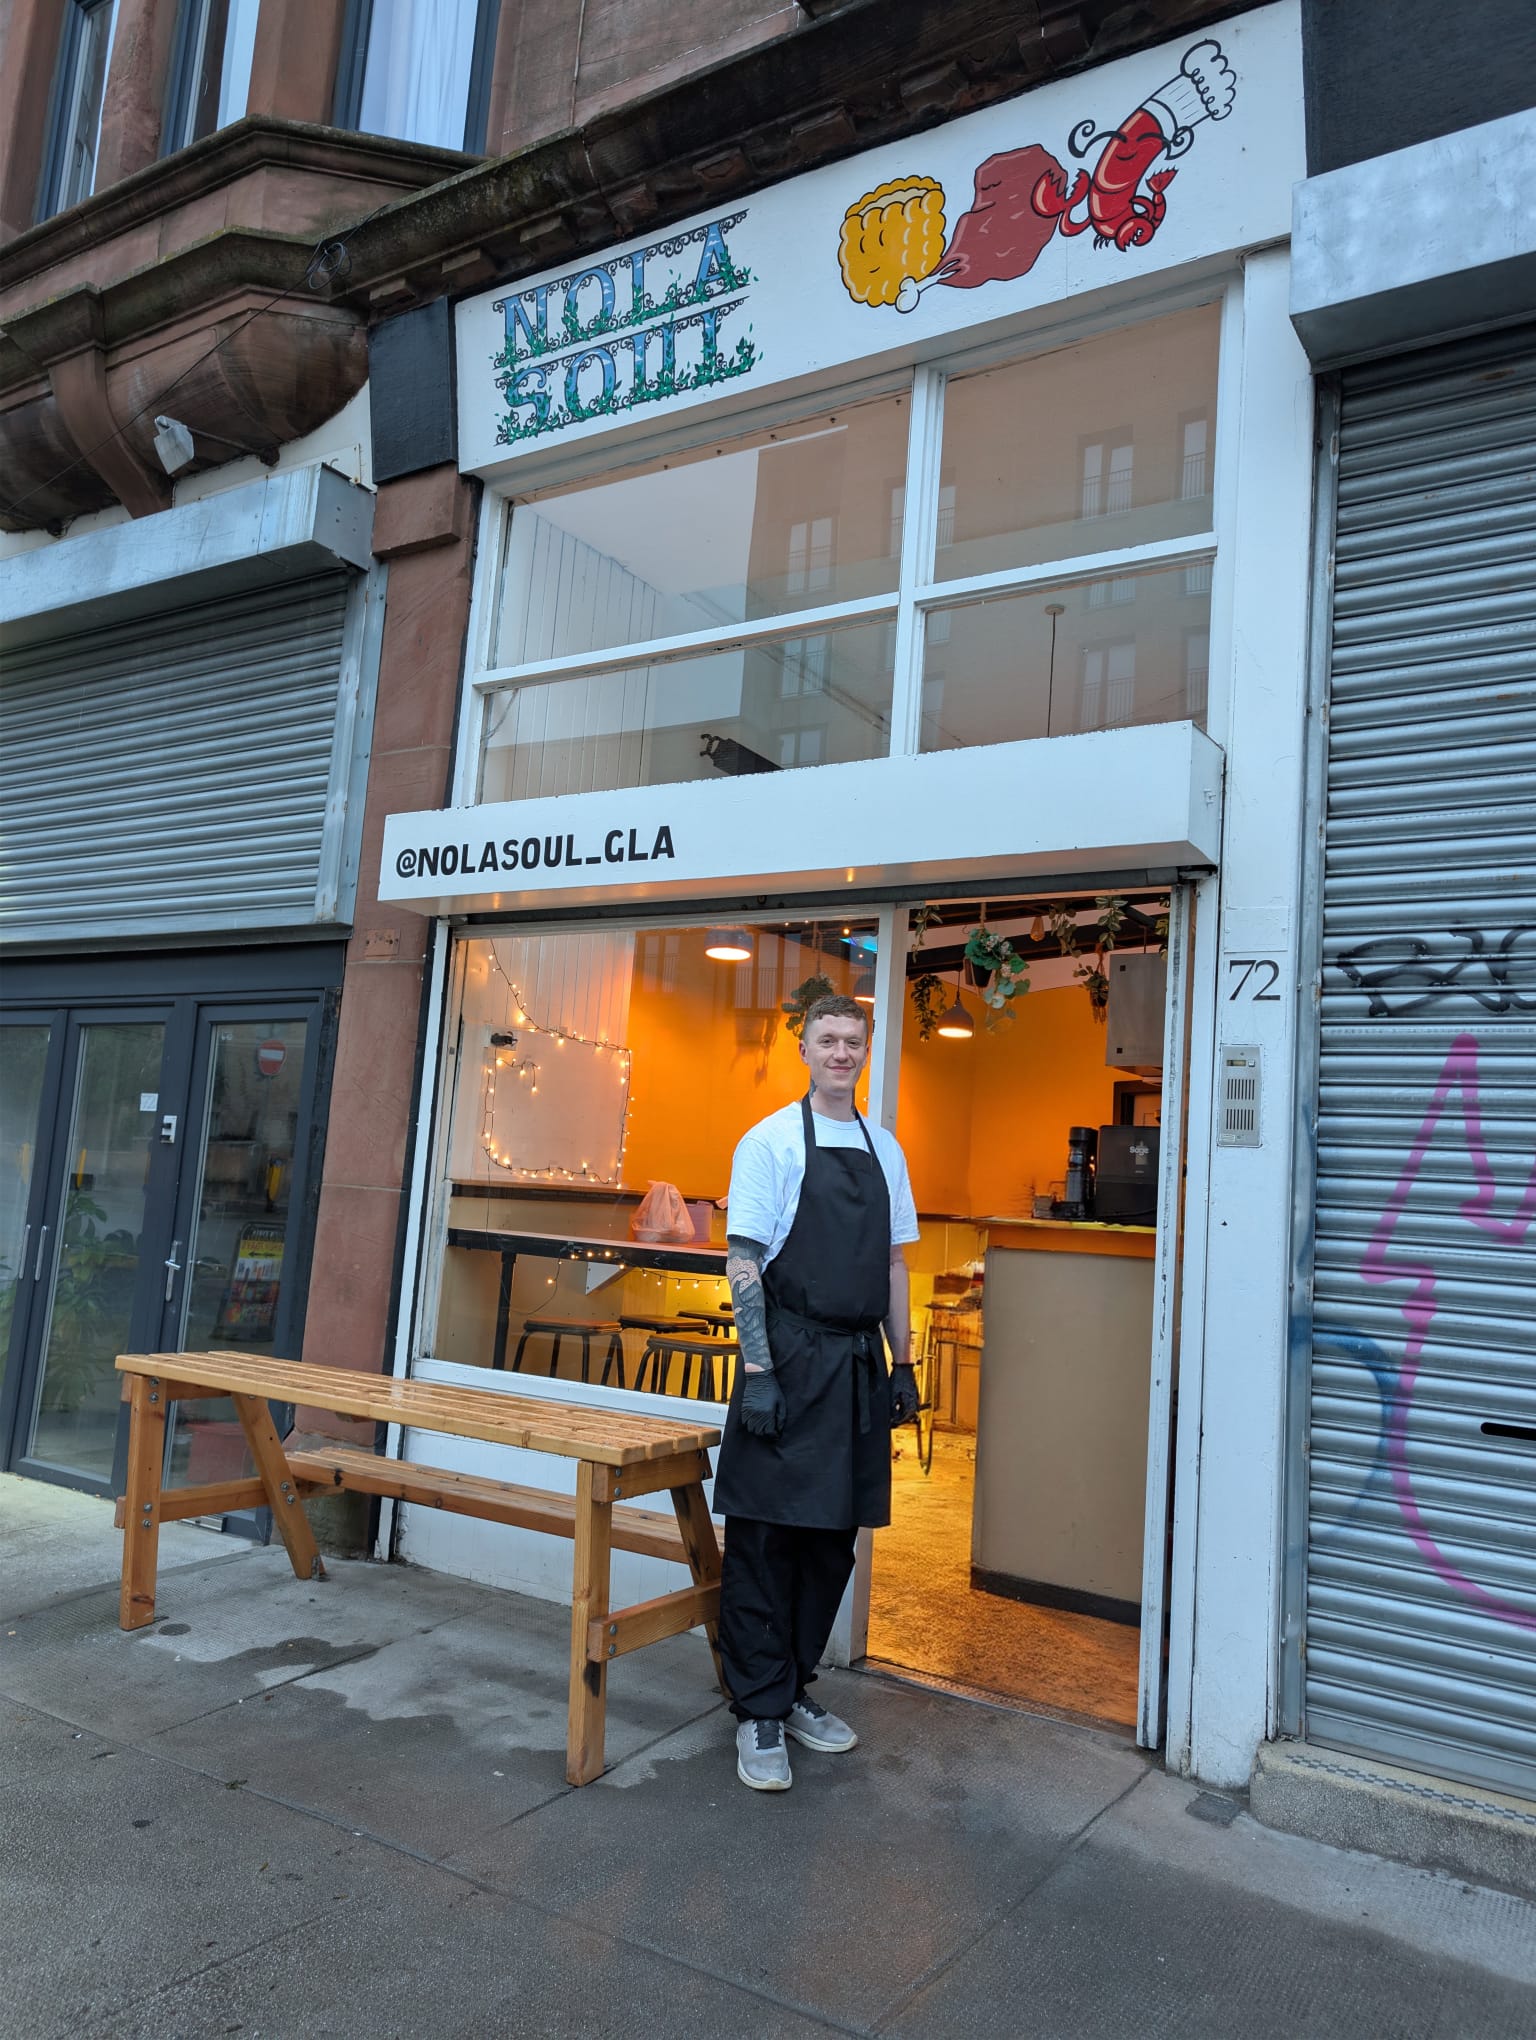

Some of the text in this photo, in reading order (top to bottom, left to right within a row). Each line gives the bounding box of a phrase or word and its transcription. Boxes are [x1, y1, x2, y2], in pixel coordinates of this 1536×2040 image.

[493, 210, 751, 369] NOLA
[494, 298, 755, 445] SOUL
[396, 825, 676, 879] @NOLASOUL_GLA
[1229, 959, 1281, 1001] 72
